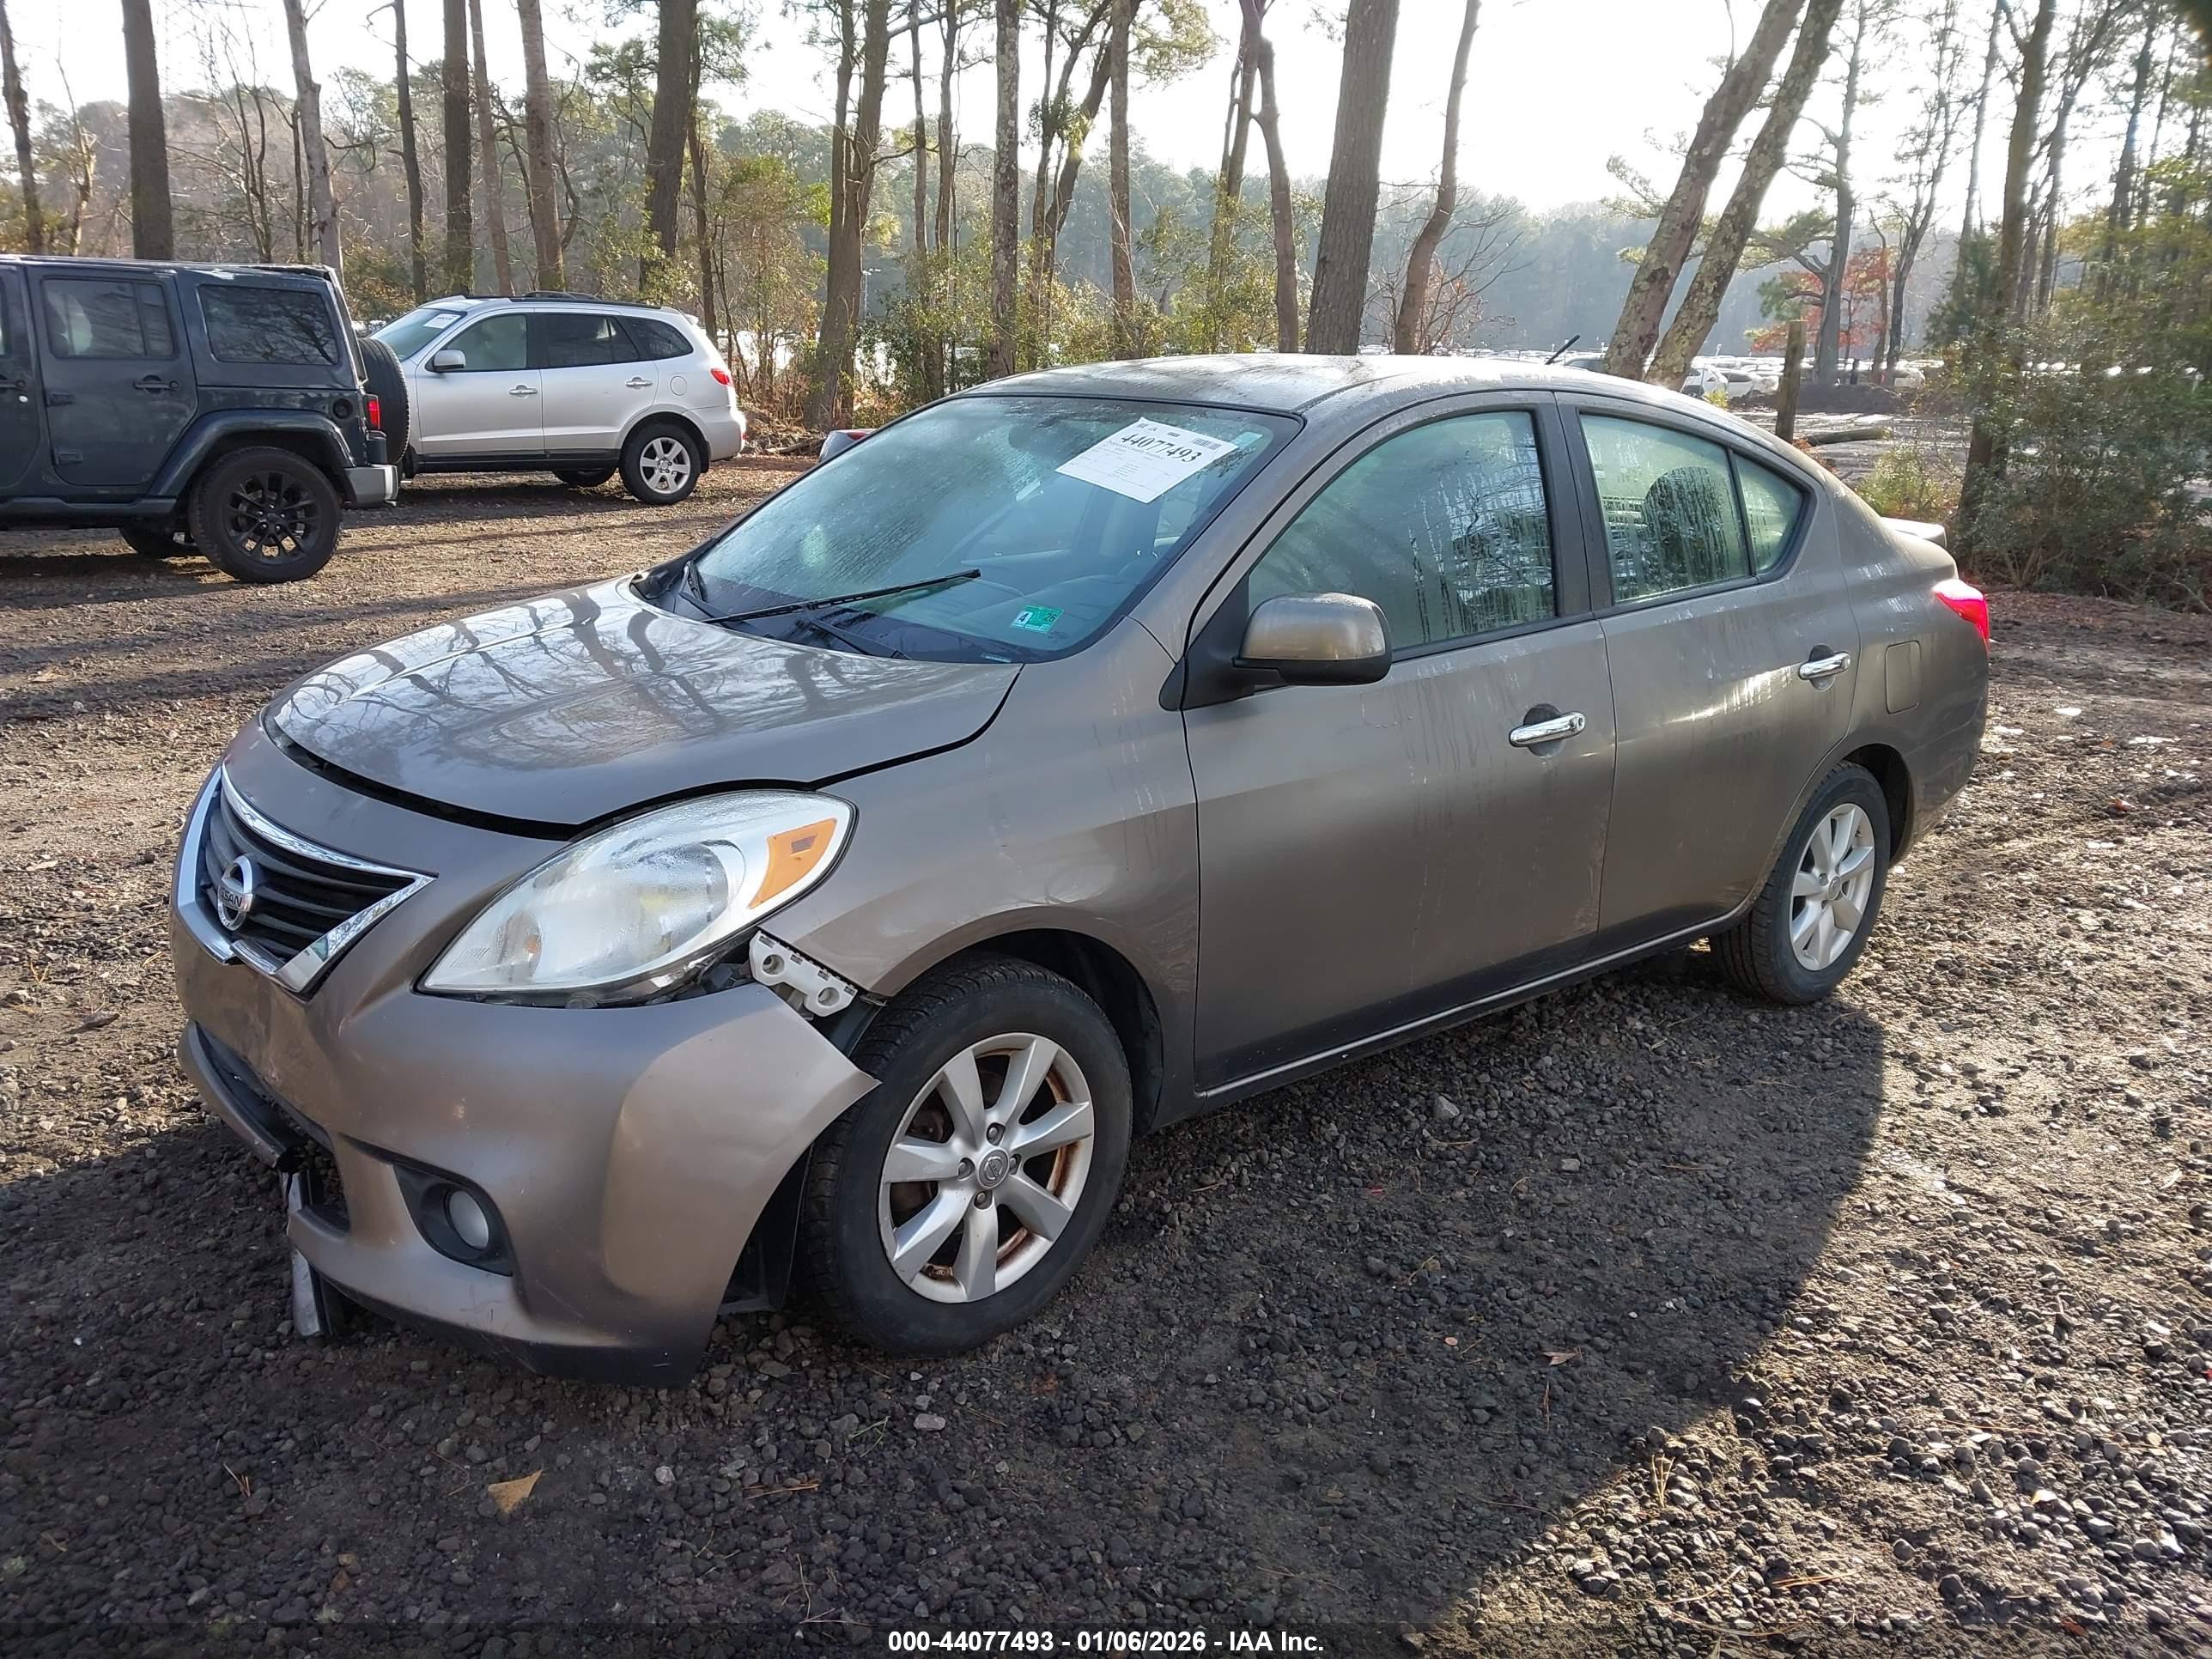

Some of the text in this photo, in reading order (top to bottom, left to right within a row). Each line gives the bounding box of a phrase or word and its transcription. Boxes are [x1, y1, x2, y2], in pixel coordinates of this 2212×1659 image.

[1121, 434, 1202, 462] 44077493
[1018, 612, 1057, 623] 4 26
